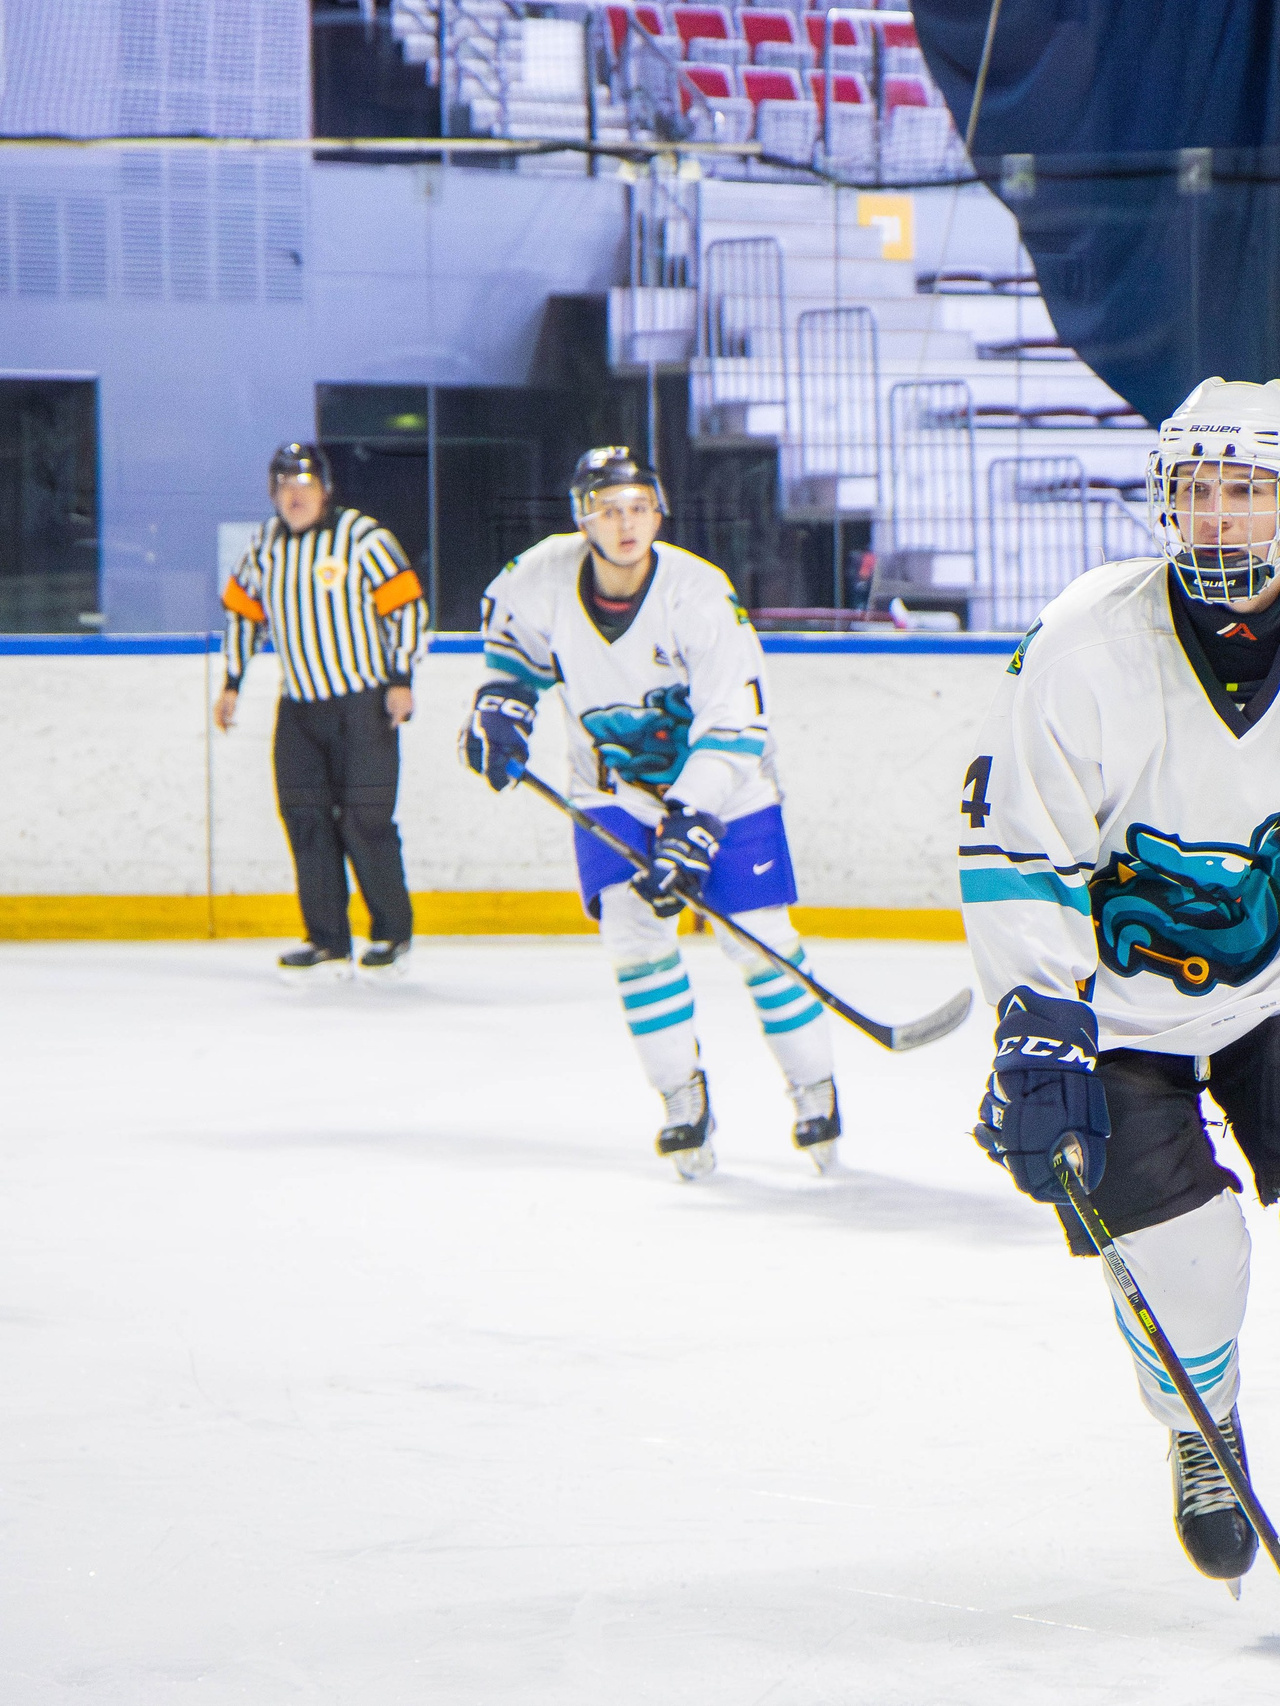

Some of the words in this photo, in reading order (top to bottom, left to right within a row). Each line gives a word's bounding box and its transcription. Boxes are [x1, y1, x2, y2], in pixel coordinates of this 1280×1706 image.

[1189, 424, 1242, 434] BAUER
[960, 755, 994, 829] 4
[996, 1035, 1097, 1072] CCM
